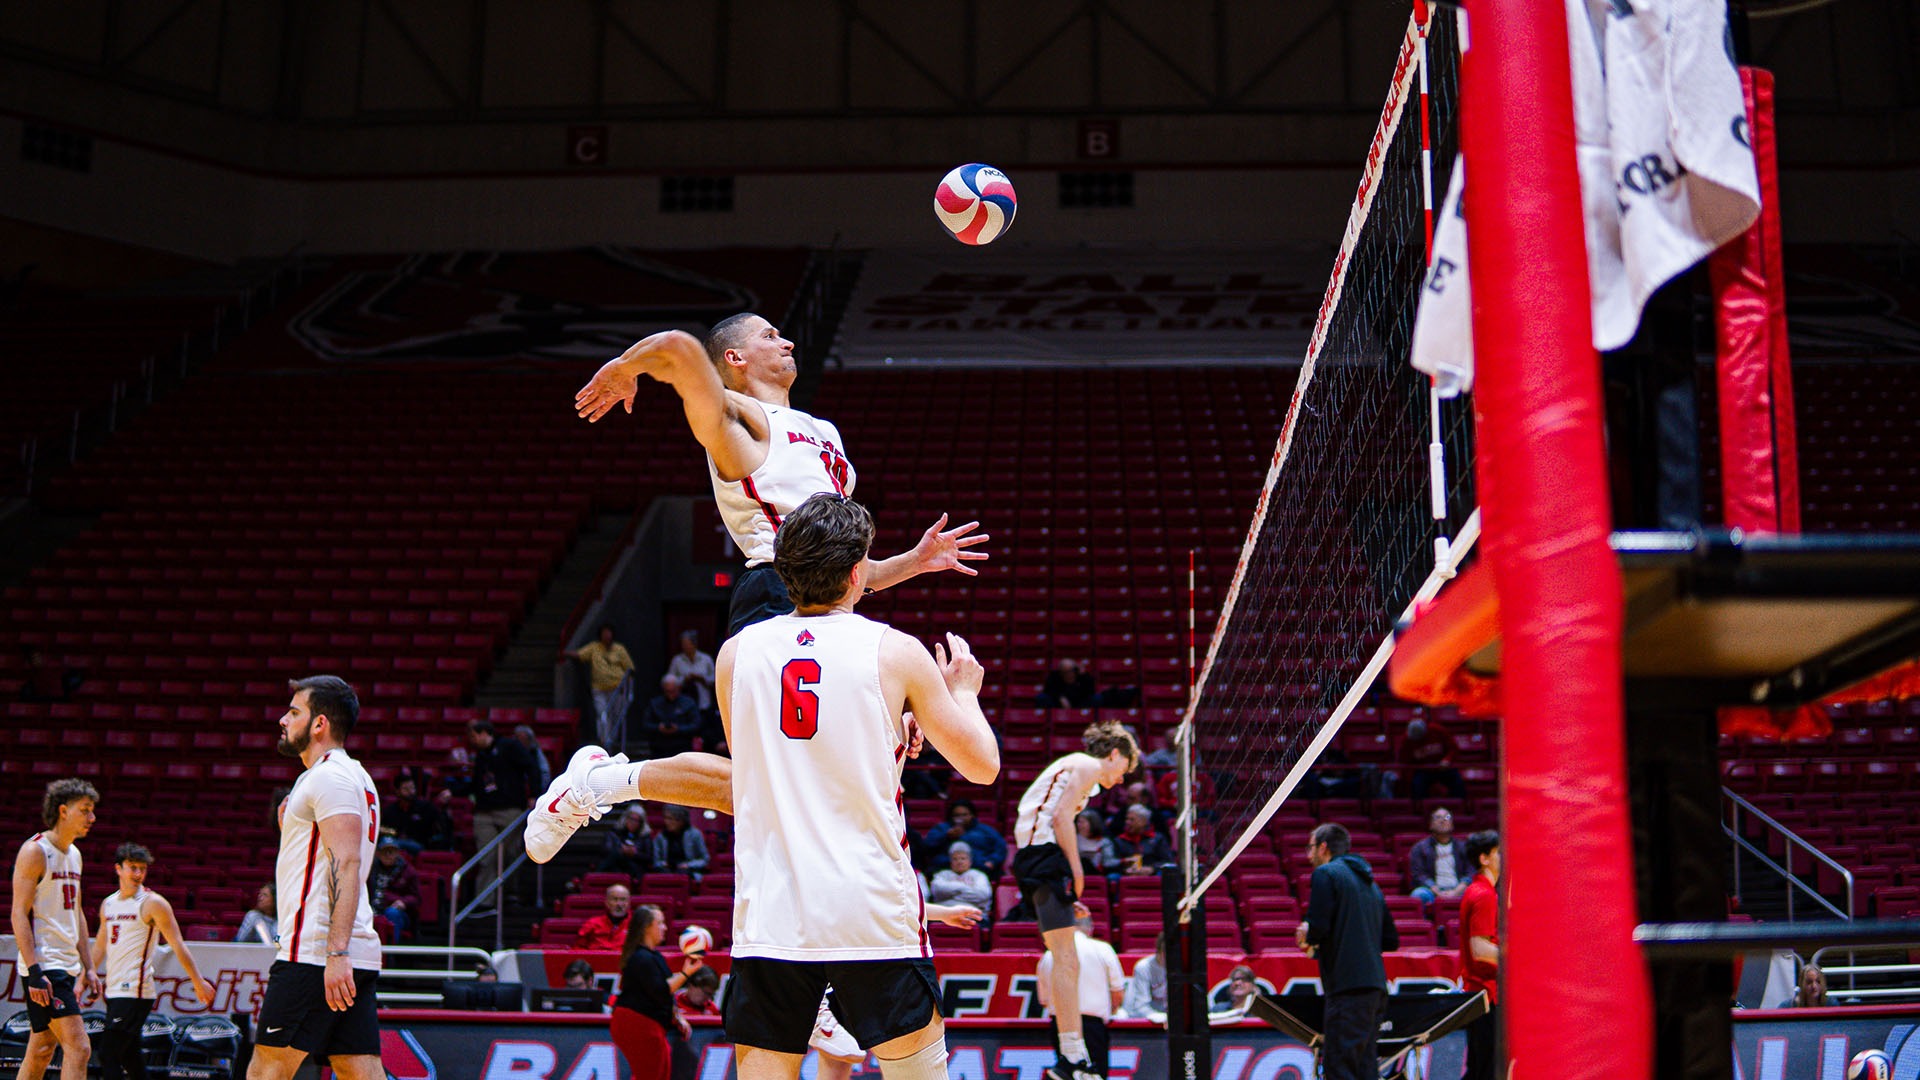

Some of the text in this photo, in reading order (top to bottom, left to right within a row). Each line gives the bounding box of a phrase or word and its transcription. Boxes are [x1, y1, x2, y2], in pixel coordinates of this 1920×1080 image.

[575, 136, 599, 161] C
[1087, 131, 1110, 156] B
[779, 658, 821, 740] 6
[111, 925, 120, 945] 5
